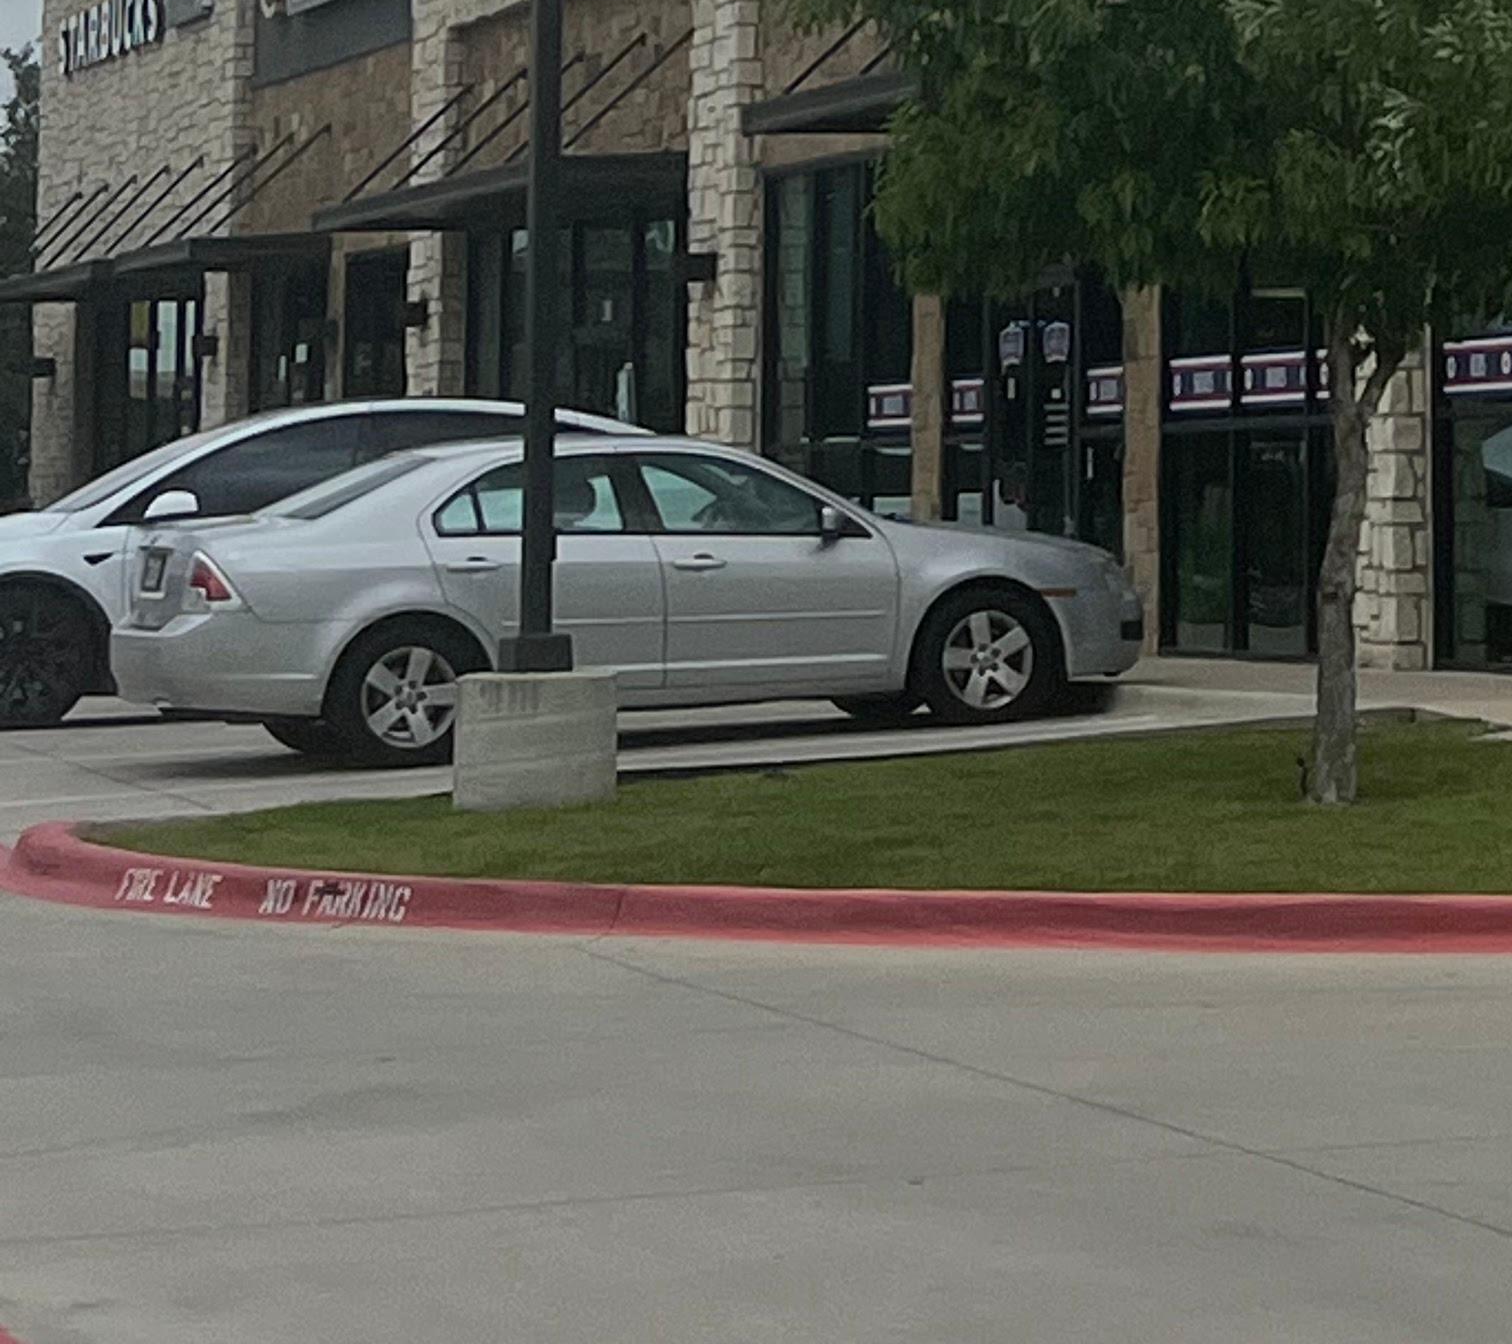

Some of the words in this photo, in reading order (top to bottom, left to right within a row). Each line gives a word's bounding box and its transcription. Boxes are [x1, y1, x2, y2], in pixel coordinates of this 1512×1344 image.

[115, 868, 163, 901] FIRE
[163, 870, 223, 909] LANE
[258, 879, 298, 914] NO
